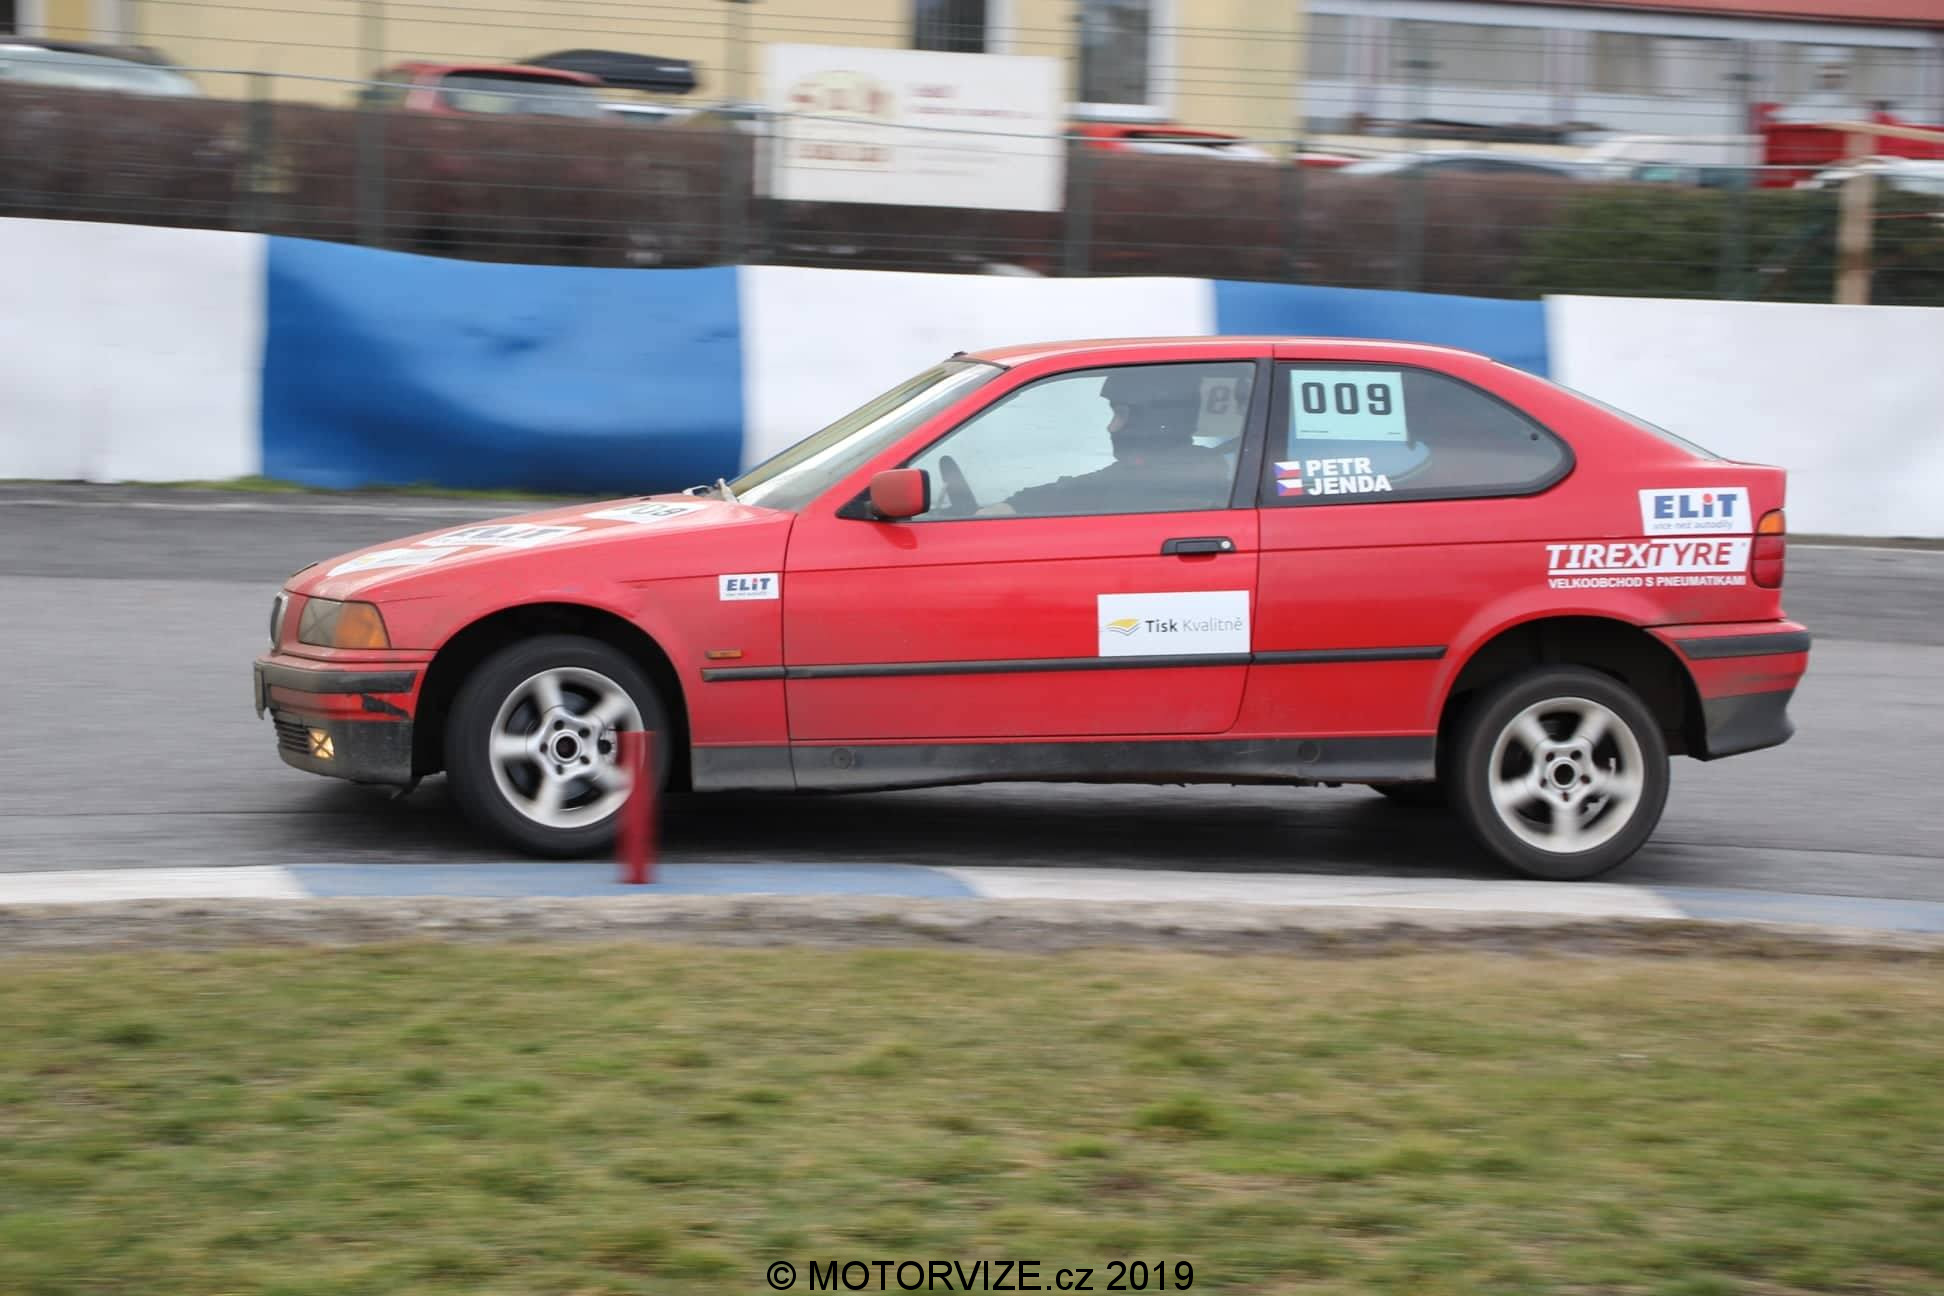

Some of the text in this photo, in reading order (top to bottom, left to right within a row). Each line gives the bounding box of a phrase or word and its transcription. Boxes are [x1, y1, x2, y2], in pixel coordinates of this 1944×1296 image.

[1302, 382, 1393, 416] 009
[1305, 457, 1373, 477] PETR
[1307, 474, 1393, 496] JENDA
[1548, 575, 1746, 589] VELKOOBCHOD S PNEUMATIKAMI
[1145, 617, 1242, 633] Tisk Kvalitně
